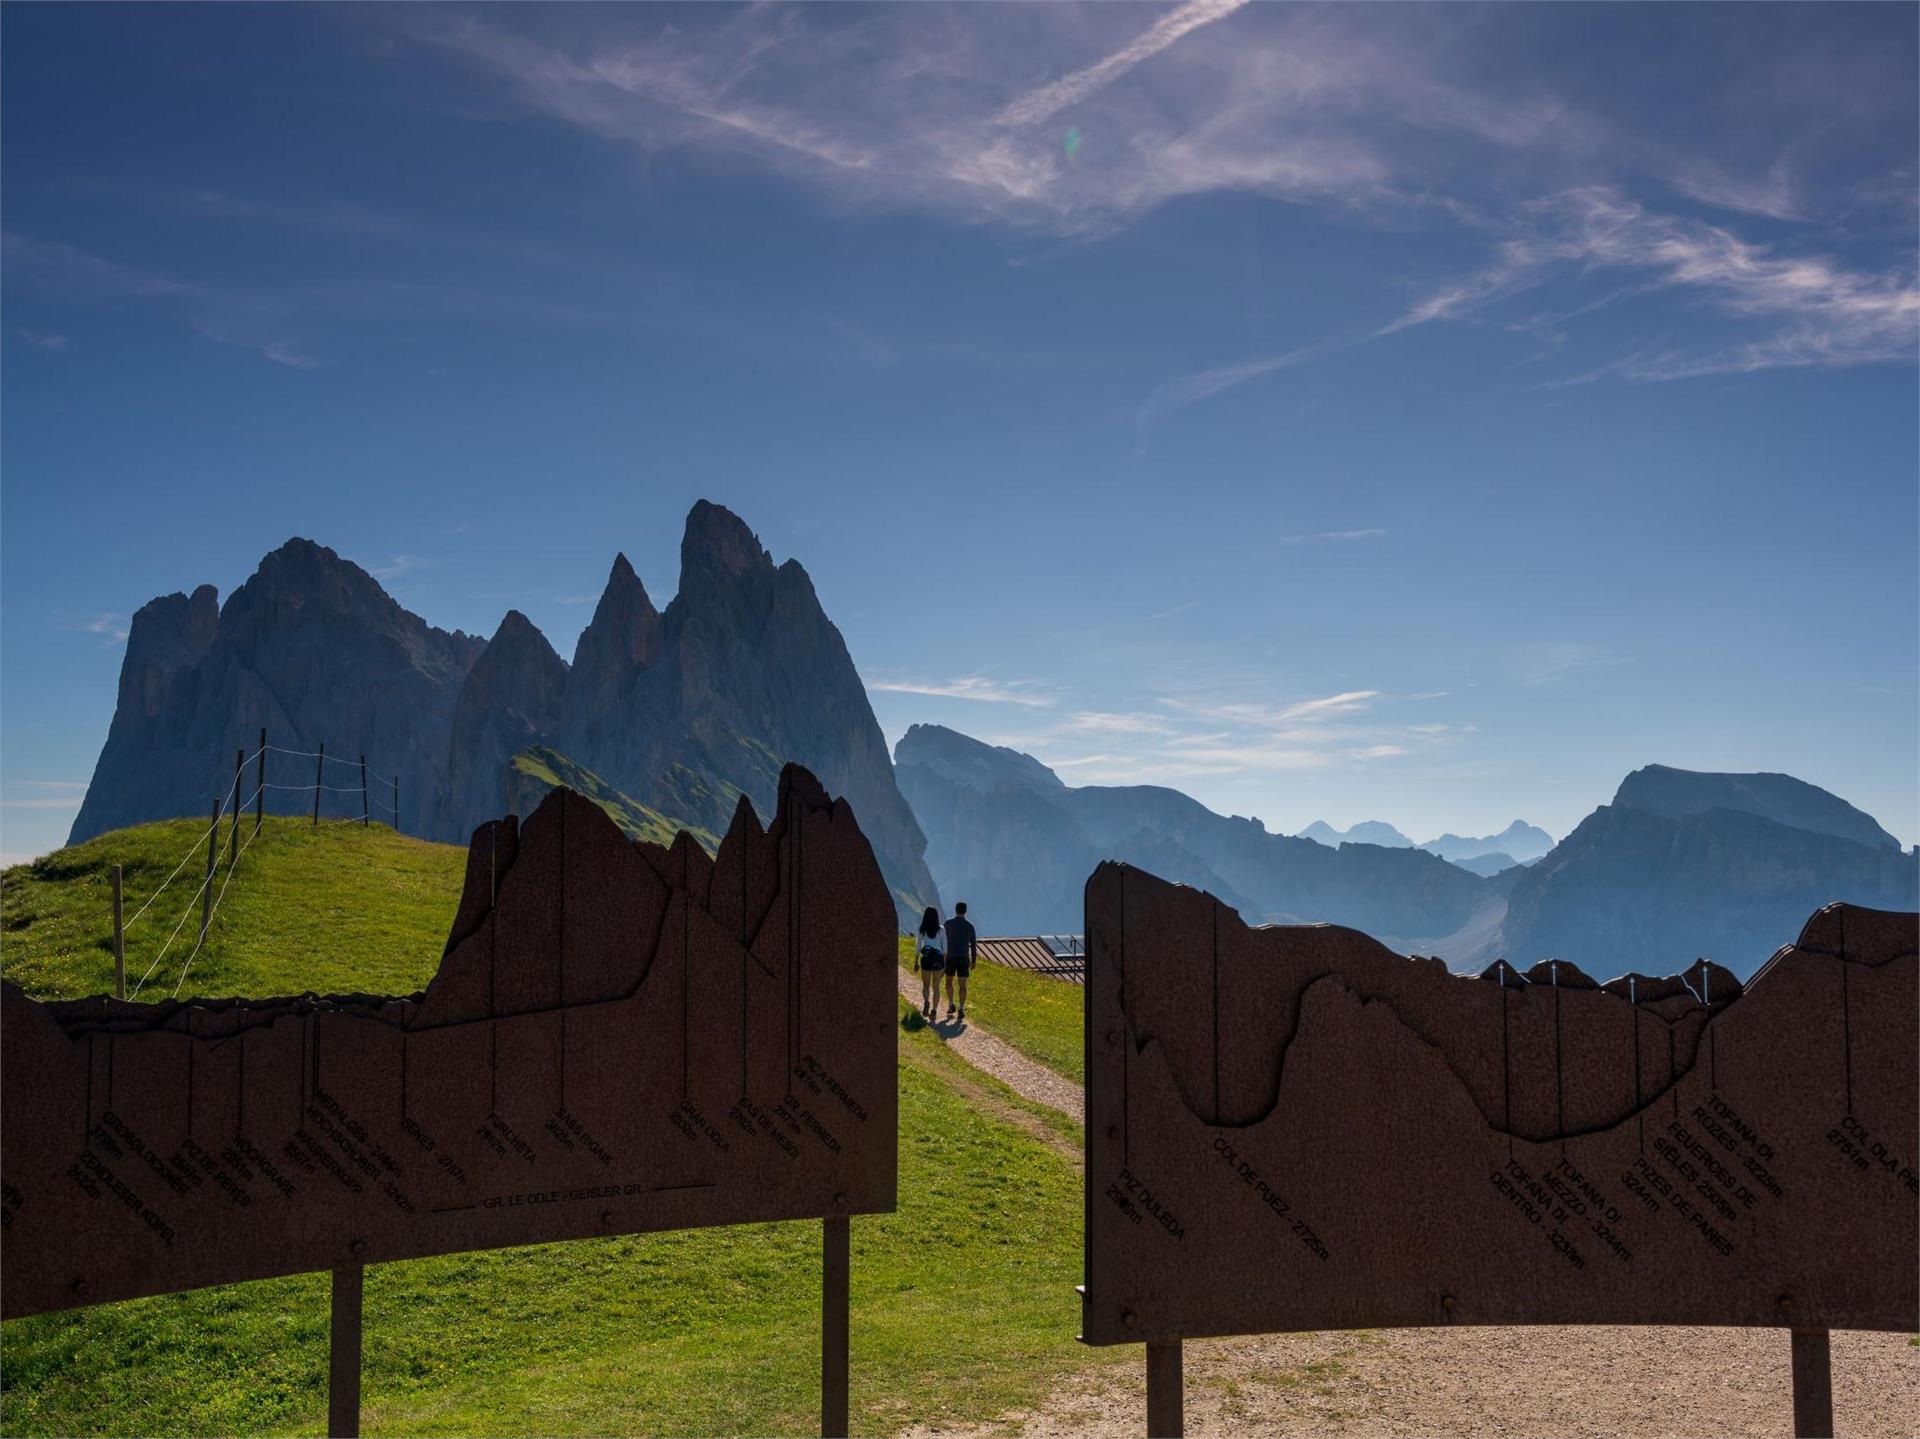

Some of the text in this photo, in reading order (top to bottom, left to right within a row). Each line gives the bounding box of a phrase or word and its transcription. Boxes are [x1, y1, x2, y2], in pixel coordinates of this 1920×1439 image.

[306, 1105, 381, 1181] HOCHSCHOBER
[486, 1112, 536, 1164] FURCHETA
[555, 1106, 612, 1166] SASS RIGAIS
[680, 1100, 706, 1128] GRAN
[757, 1114, 773, 1130] DE
[800, 1110, 841, 1155] FERMEDA
[1708, 1094, 1776, 1162] TOFANA DI
[1842, 1116, 1868, 1146] COL
[1869, 1142, 1898, 1172] DLA
[181, 1139, 250, 1207] PIZ DE PERES
[232, 1133, 296, 1199] HOCHGRABE
[1692, 1106, 1738, 1152] ROZES
[1743, 1156, 1783, 1198] 3225m
[1826, 1129, 1869, 1170] 2751m
[509, 1194, 523, 1206] LE
[527, 1191, 560, 1204] ODLE
[569, 1185, 621, 1200] GEISLER
[623, 1184, 644, 1195] GR.
[1118, 1168, 1184, 1241] PIZ DULEDA
[1213, 1137, 1237, 1167] COL
[1237, 1162, 1258, 1185] DE
[1255, 1181, 1290, 1217] PUEZ
[1291, 1220, 1329, 1261] 2725m
[1489, 1171, 1542, 1223] DENTRO
[1505, 1157, 1569, 1224] TOFANA DI
[1542, 1171, 1587, 1216] MEZZO
[1592, 1220, 1633, 1261] 3244m
[1556, 1157, 1622, 1224] TOFANA DI
[1621, 1171, 1660, 1213] 3244m
[1633, 1157, 1734, 1256] PIZES DE FANES
[1734, 1186, 1757, 1209] DE
[140, 1208, 174, 1245] KOFEL
